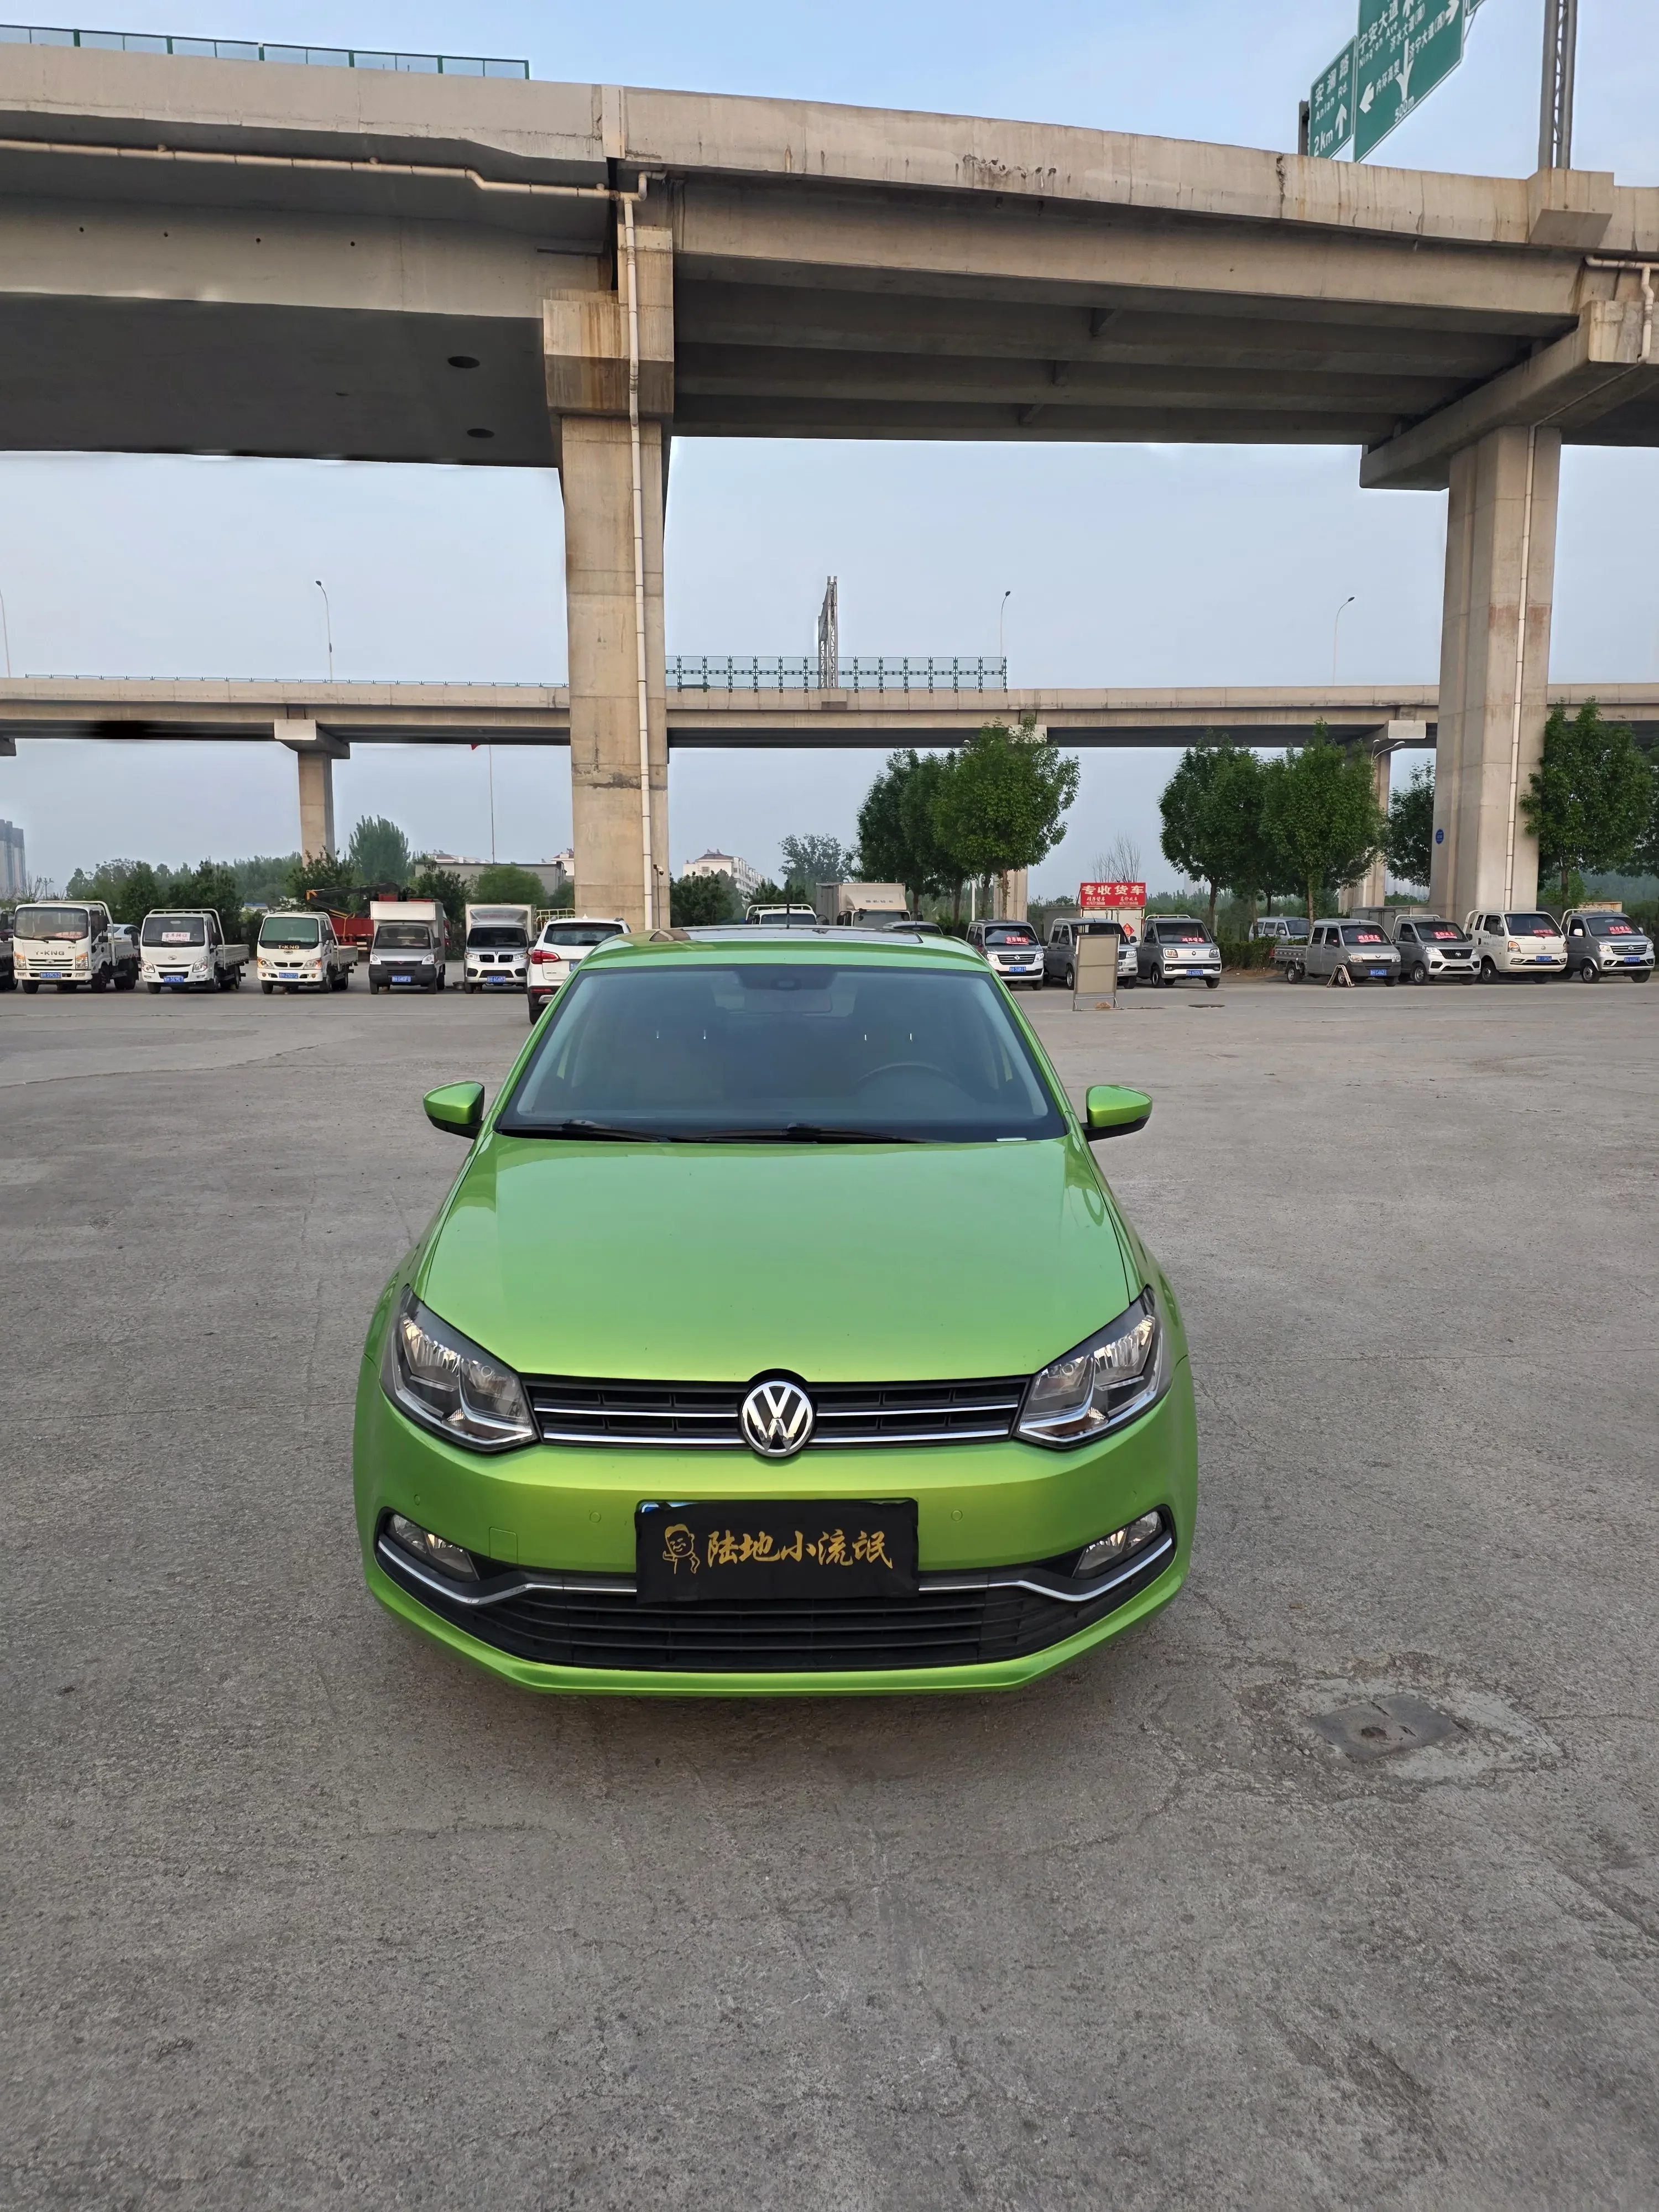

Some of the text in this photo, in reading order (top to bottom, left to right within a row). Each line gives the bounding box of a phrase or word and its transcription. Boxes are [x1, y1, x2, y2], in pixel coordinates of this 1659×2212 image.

[1315, 97, 1334, 123] Anlan
[1394, 96, 1415, 122] 500m
[1082, 885, 1144, 895] 专收货车
[707, 1528, 893, 1569] 陆地小流氓
